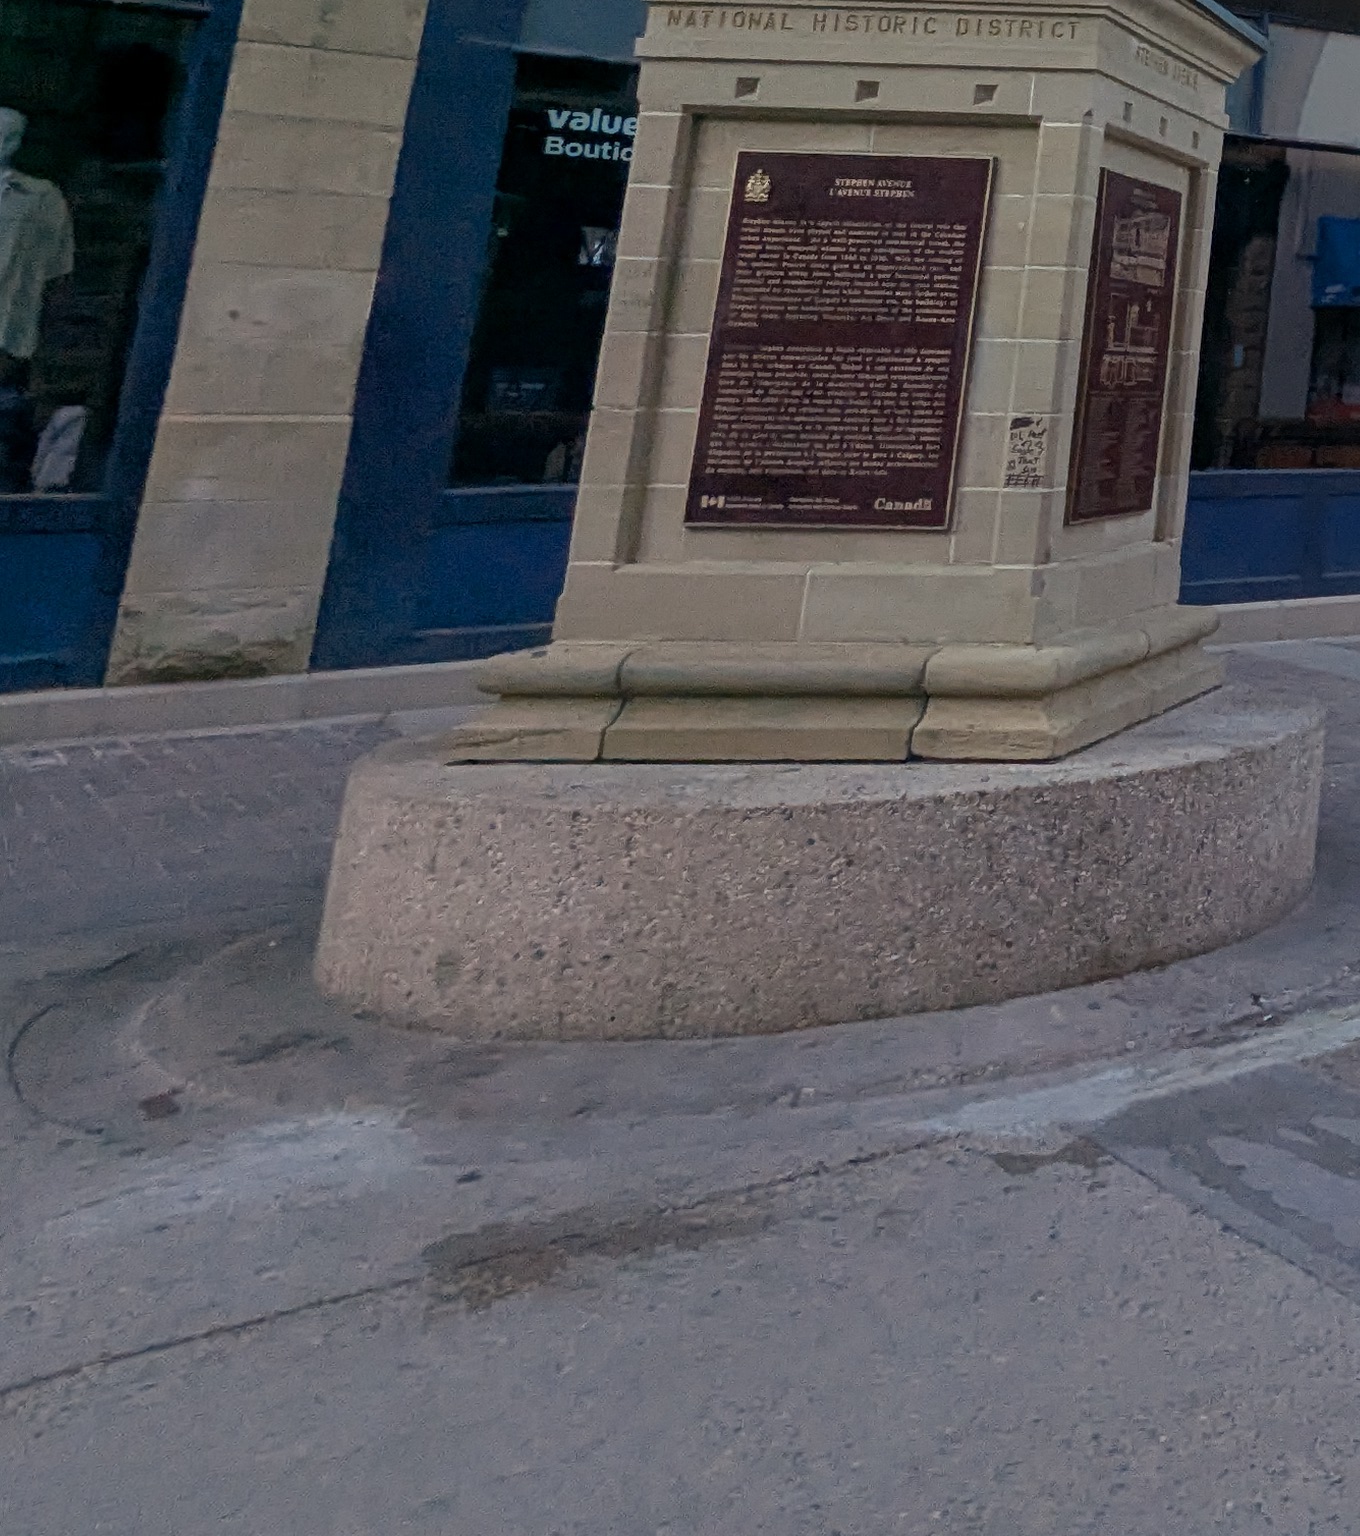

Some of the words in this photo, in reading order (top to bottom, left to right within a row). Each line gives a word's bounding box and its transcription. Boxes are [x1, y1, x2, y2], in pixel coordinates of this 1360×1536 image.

[666, 9, 794, 32] NATIONAL
[812, 13, 937, 34] HISTORIC
[955, 18, 1081, 40] DISTRICT
[547, 107, 638, 136] value
[874, 497, 933, 511] Canada
